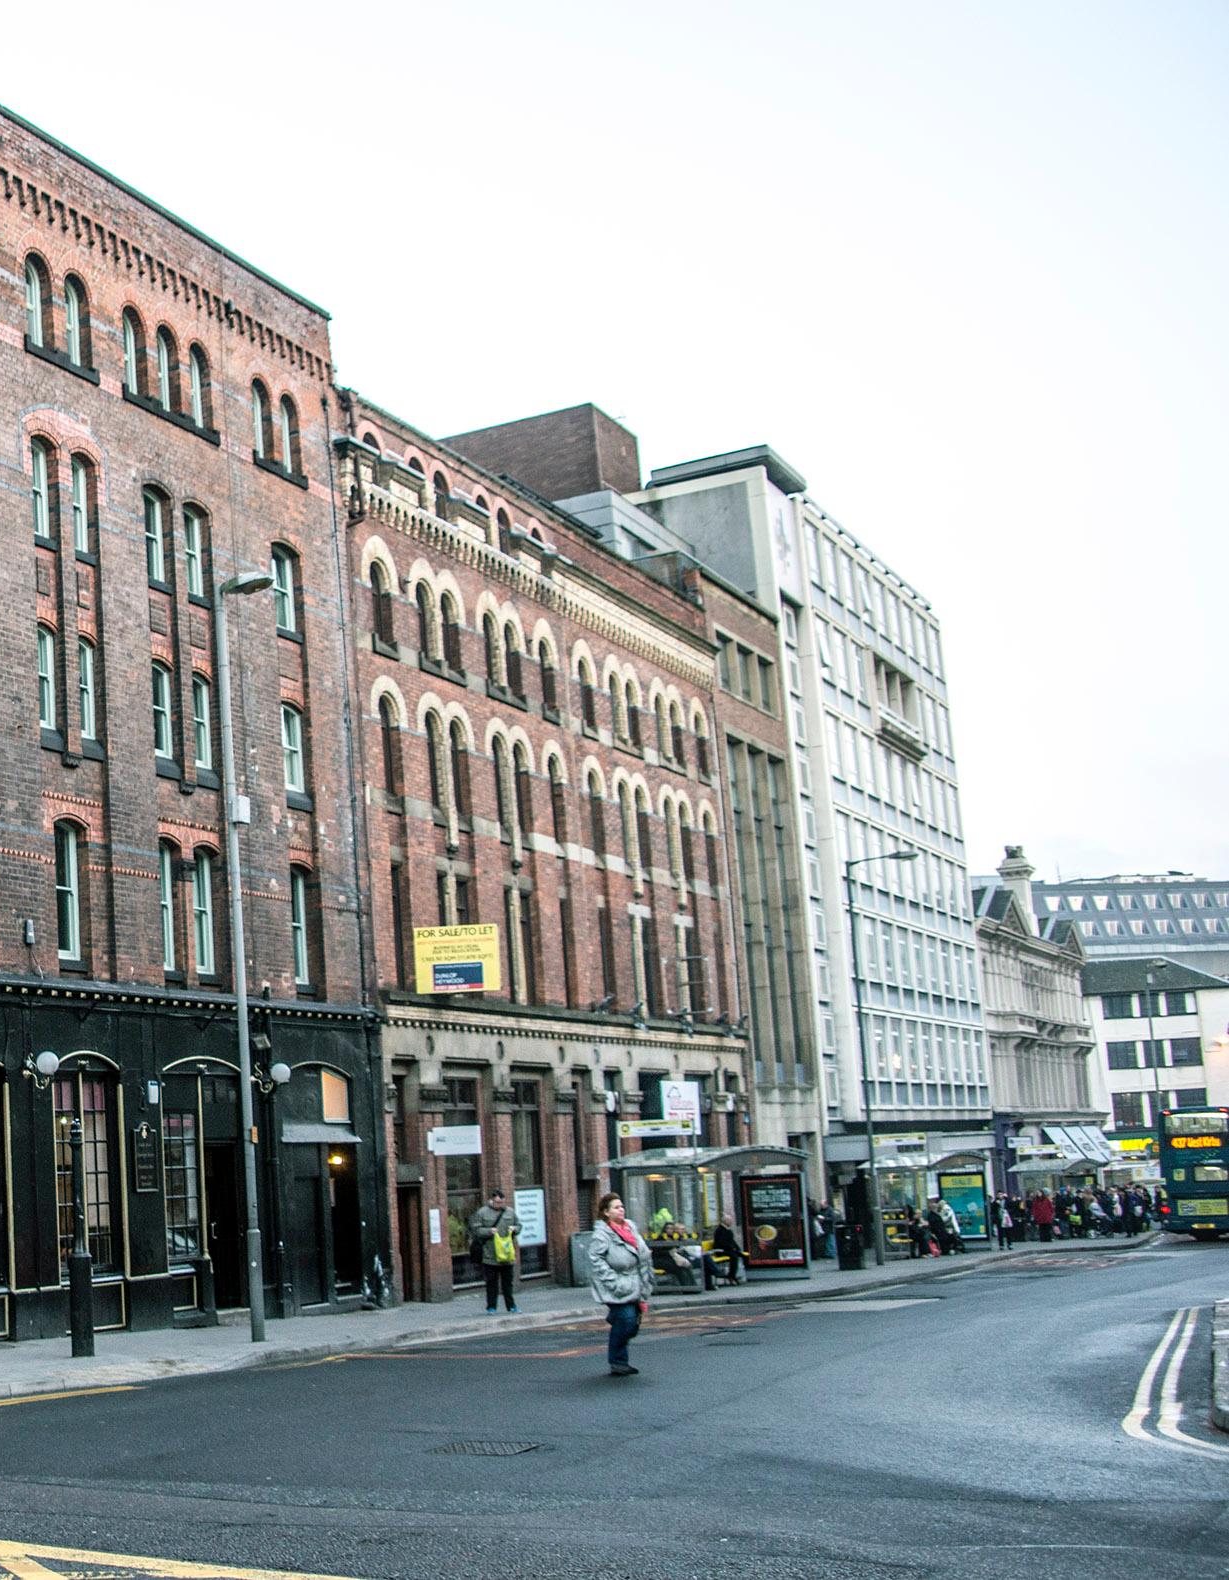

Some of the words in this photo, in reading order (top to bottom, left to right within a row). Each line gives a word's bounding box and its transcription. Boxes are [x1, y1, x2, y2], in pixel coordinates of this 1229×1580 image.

[417, 929, 436, 939] FOR
[438, 927, 477, 937] SALE/TO
[478, 926, 494, 935] LET
